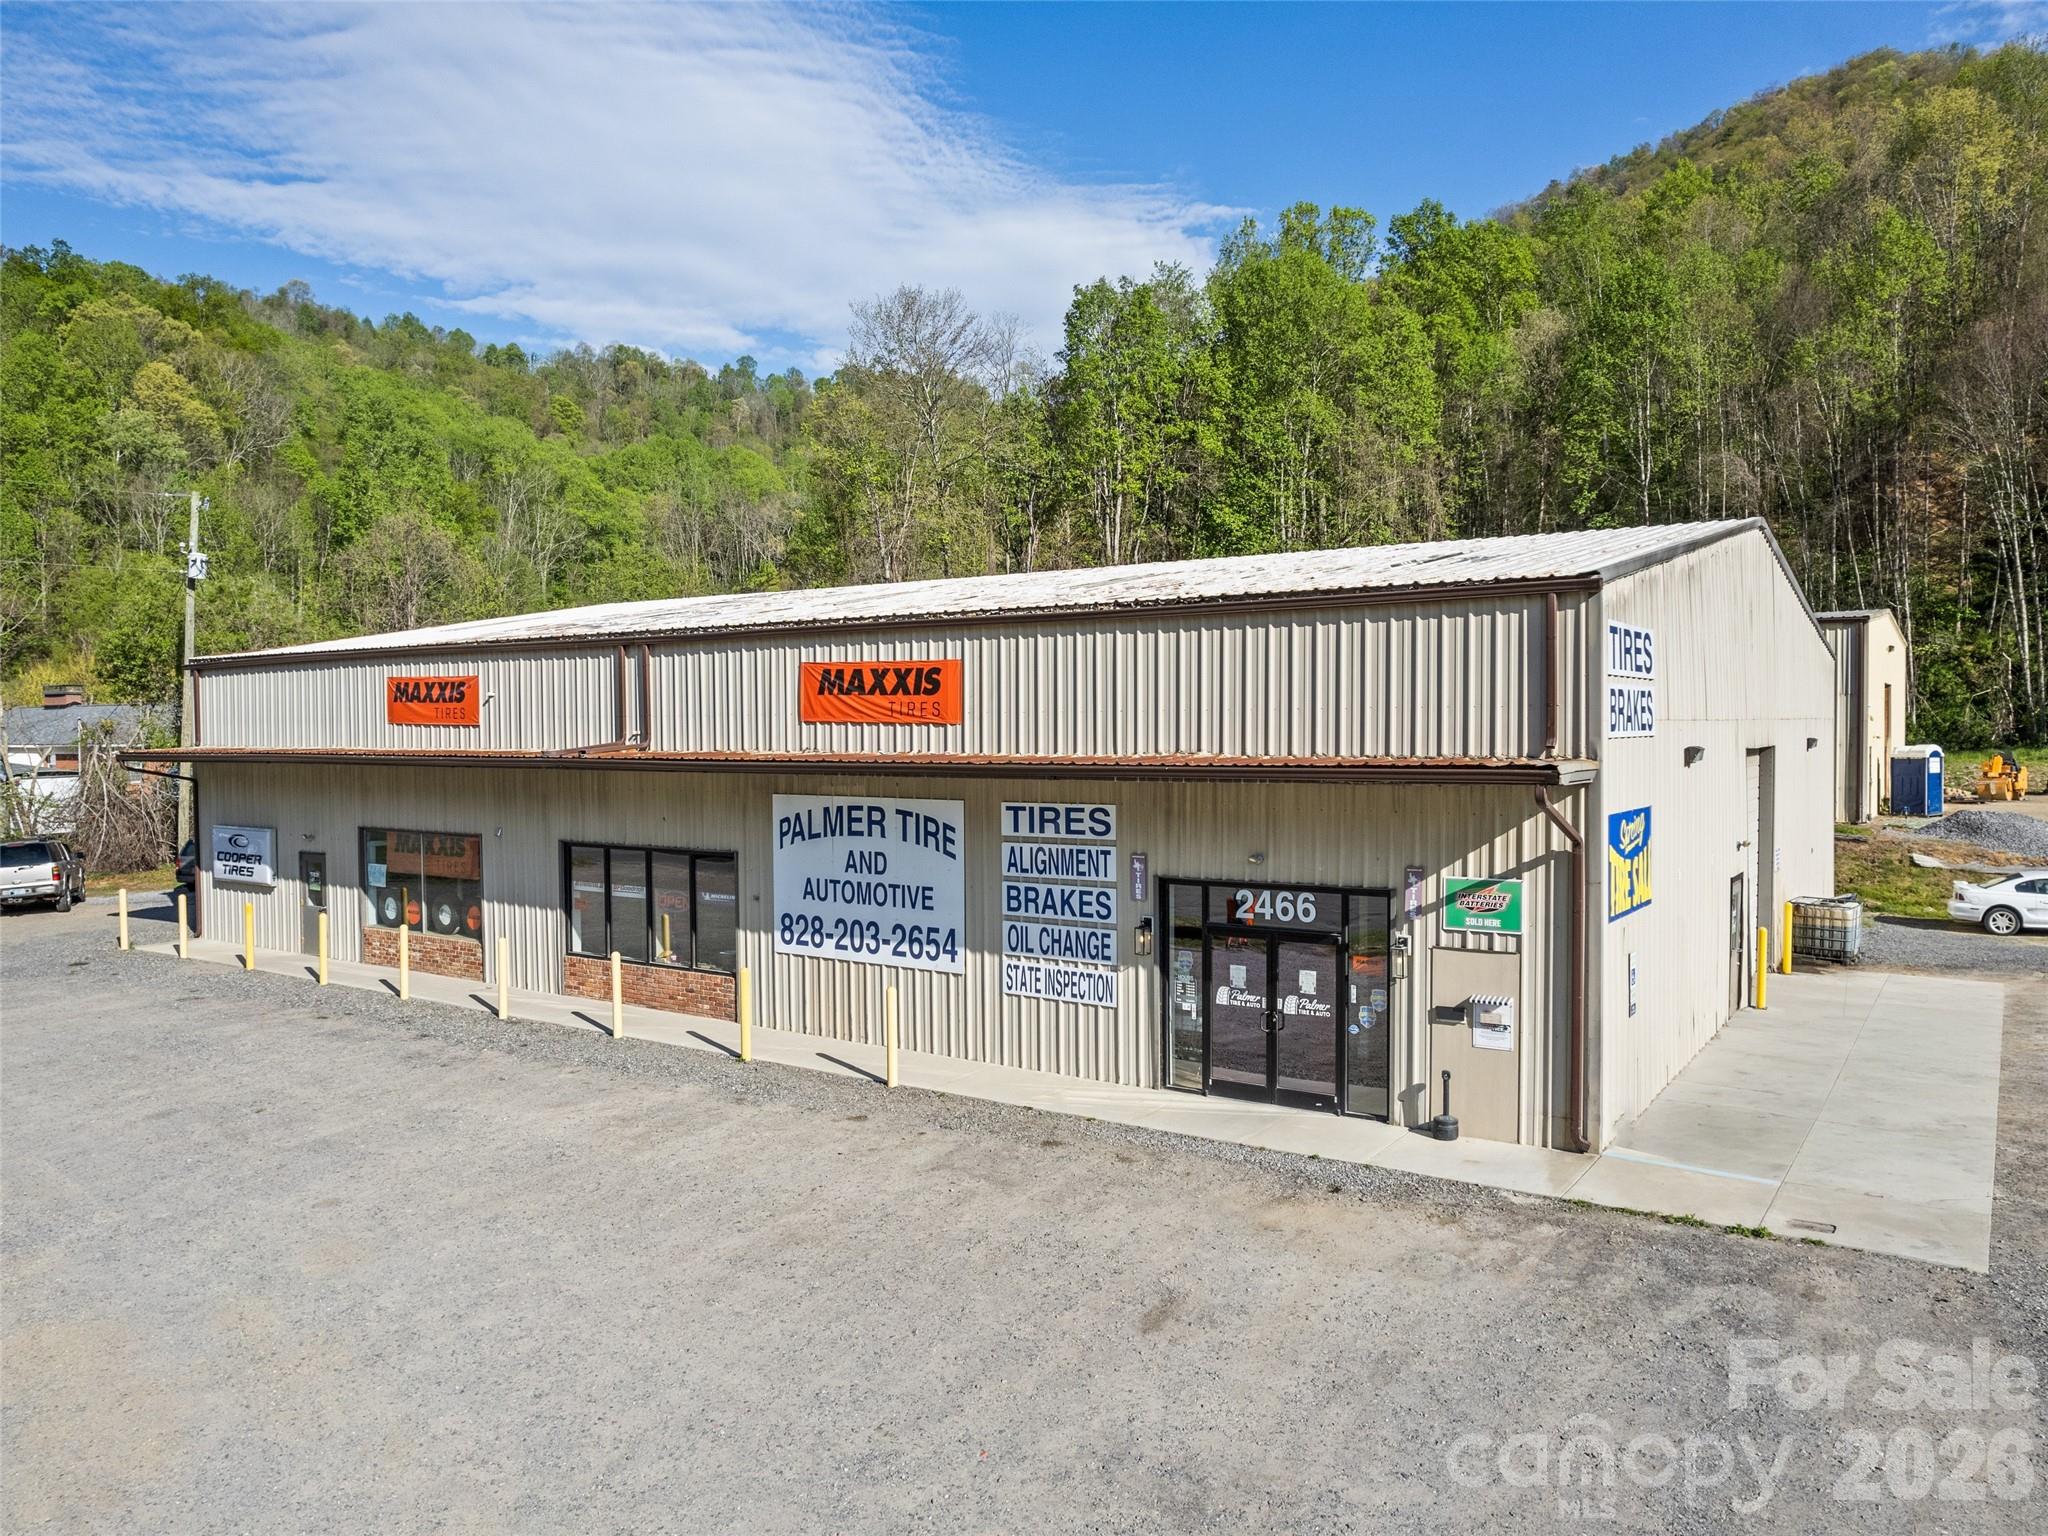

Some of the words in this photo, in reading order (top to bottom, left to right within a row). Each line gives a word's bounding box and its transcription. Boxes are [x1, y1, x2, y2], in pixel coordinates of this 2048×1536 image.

[1609, 625, 1653, 674] TIRES
[393, 681, 467, 703] MAXXIS
[817, 667, 942, 696] MAXXIS
[432, 707, 466, 720] TIRES
[888, 701, 941, 717] TIRES
[1610, 688, 1653, 732] BRAKES
[779, 805, 886, 849] PALMER
[895, 808, 957, 860] TIRE
[1005, 805, 1111, 836] TIRES
[1619, 812, 1645, 849] Spring
[216, 851, 263, 865] COOPER
[223, 864, 255, 877] TIRES
[844, 850, 888, 875] AND
[1007, 846, 1112, 878] ALIGNMENT
[803, 877, 934, 911] AUTOMOTIVE
[1608, 844, 1631, 917] TIRE
[1006, 885, 1112, 920] BRAKES
[1235, 889, 1317, 923] 2466
[1458, 893, 1508, 902] INTERSTATE
[1459, 900, 1504, 909] BATTERIES
[780, 912, 958, 963] 828-203-2654
[1465, 917, 1483, 926] SOLD
[1484, 918, 1501, 927] HERE
[1007, 924, 1034, 953] OIL
[1039, 926, 1111, 961] CHANGE
[1006, 963, 1041, 994] STATE
[1044, 966, 1113, 1003] INSPECTION
[1231, 990, 1261, 1003] Palmer
[1299, 998, 1330, 1011] Palmer
